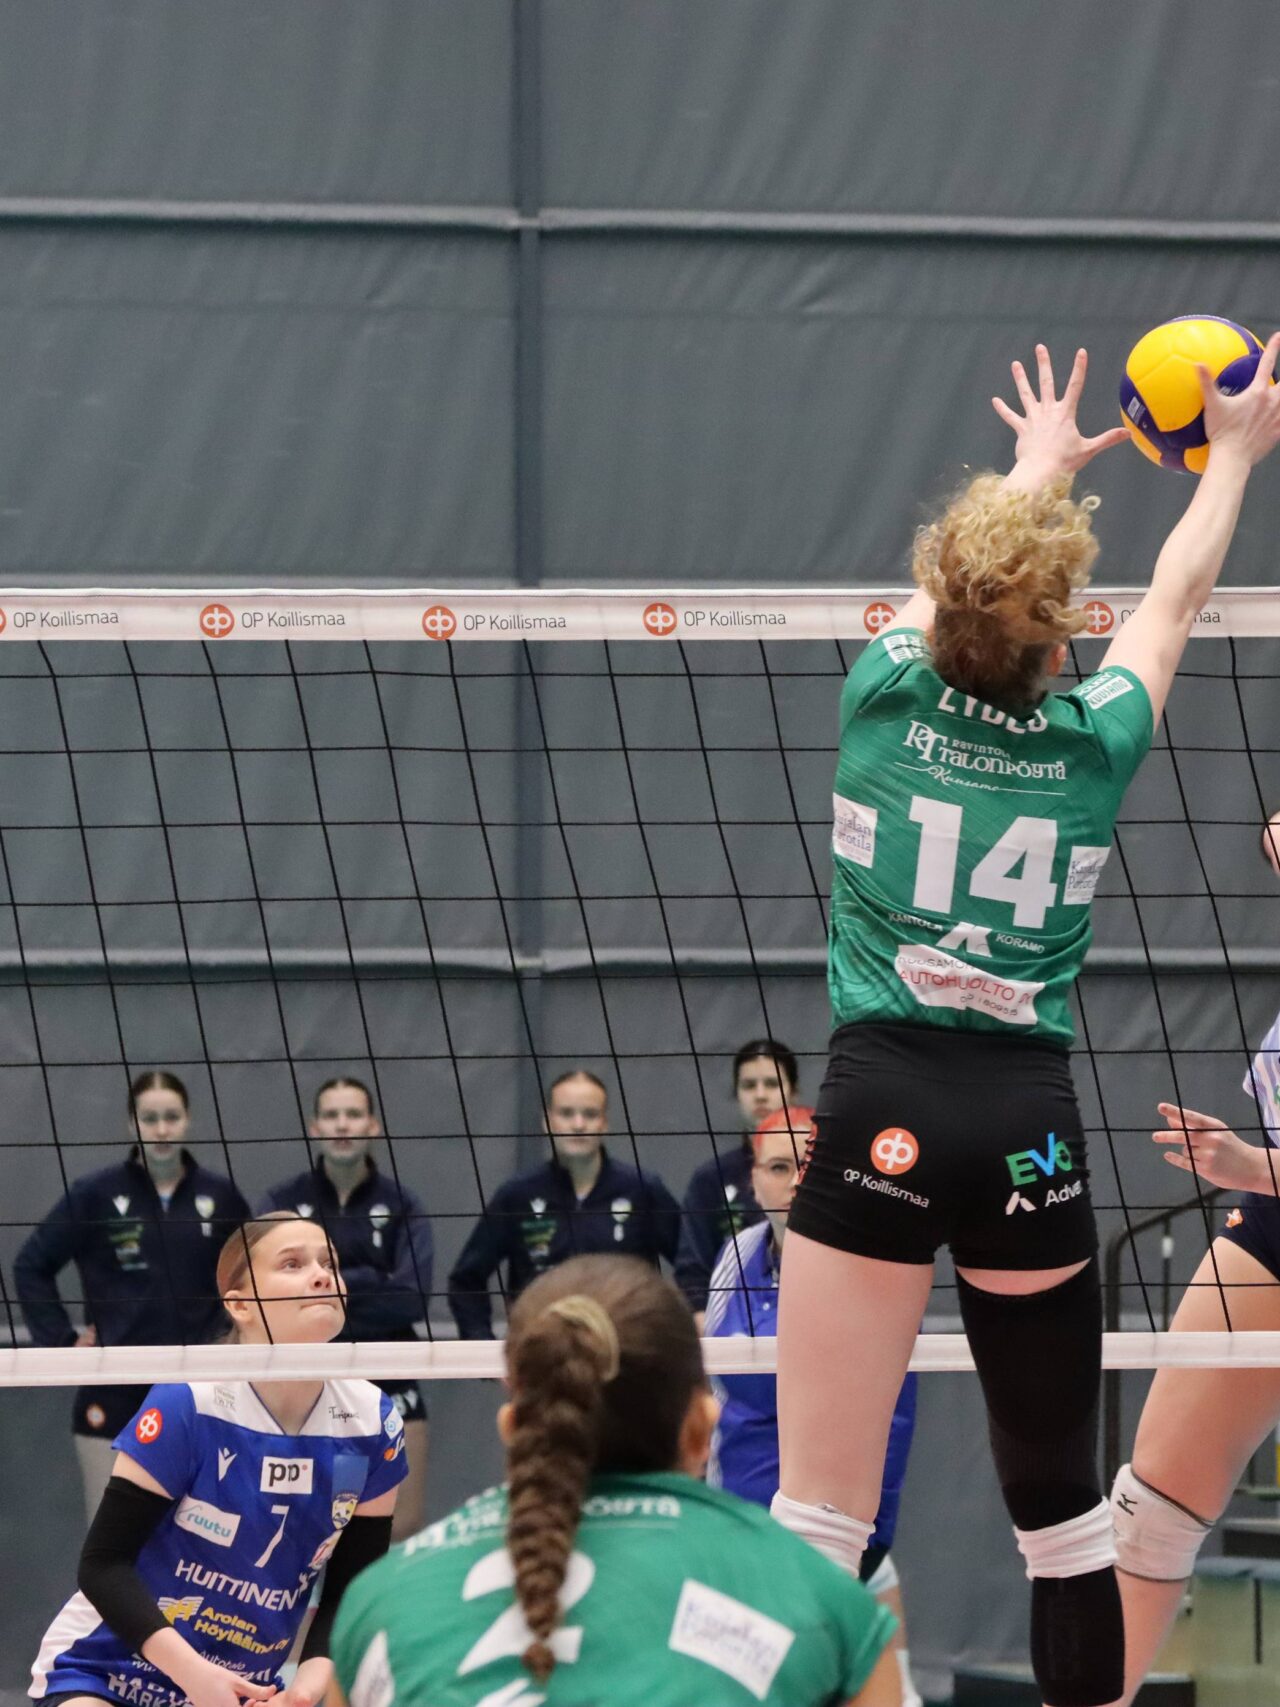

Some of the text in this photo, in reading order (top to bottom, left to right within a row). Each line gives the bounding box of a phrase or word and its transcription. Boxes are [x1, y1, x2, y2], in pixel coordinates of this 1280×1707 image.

[13, 611, 119, 628] OP Koillismaa
[241, 611, 346, 629] OP Koillismaa
[463, 615, 567, 631] OP Koillismaa
[684, 610, 787, 626] OP Koillismaa
[908, 795, 1058, 929] 14
[995, 934, 1046, 954] KORAMO
[899, 970, 1015, 1001] AUTOHUOLTO
[861, 1174, 930, 1209] Koillismaa
[187, 1511, 232, 1538] ruutu
[254, 1504, 290, 1568] 7
[175, 1558, 300, 1612] HUITTINEN
[200, 1606, 258, 1634] Arolan
